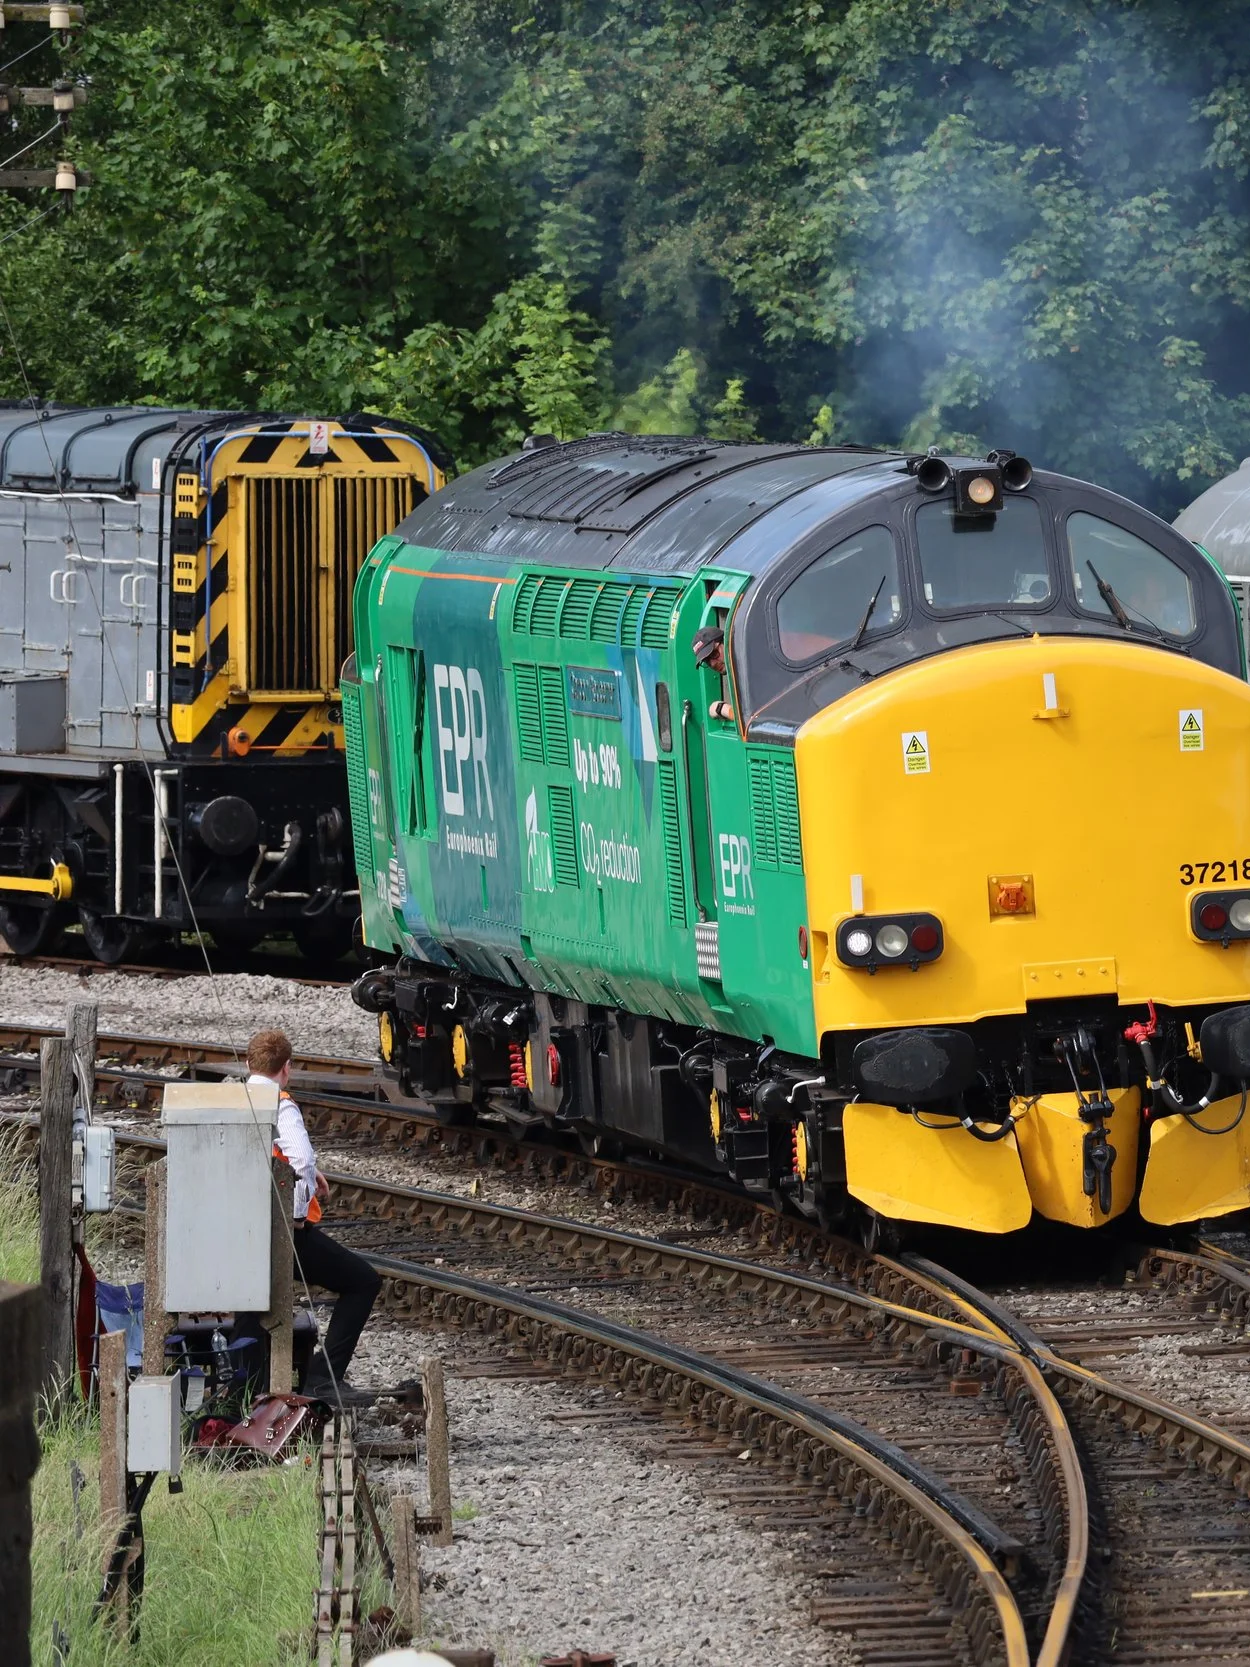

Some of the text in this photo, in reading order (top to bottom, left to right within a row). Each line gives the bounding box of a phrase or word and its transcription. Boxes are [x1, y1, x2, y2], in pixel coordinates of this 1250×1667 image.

[433, 664, 494, 821] EPR
[573, 737, 622, 793] Up to 90%
[446, 824, 498, 859] Europhoenix Rail
[600, 829, 642, 884] reduction
[718, 833, 754, 901] EPR
